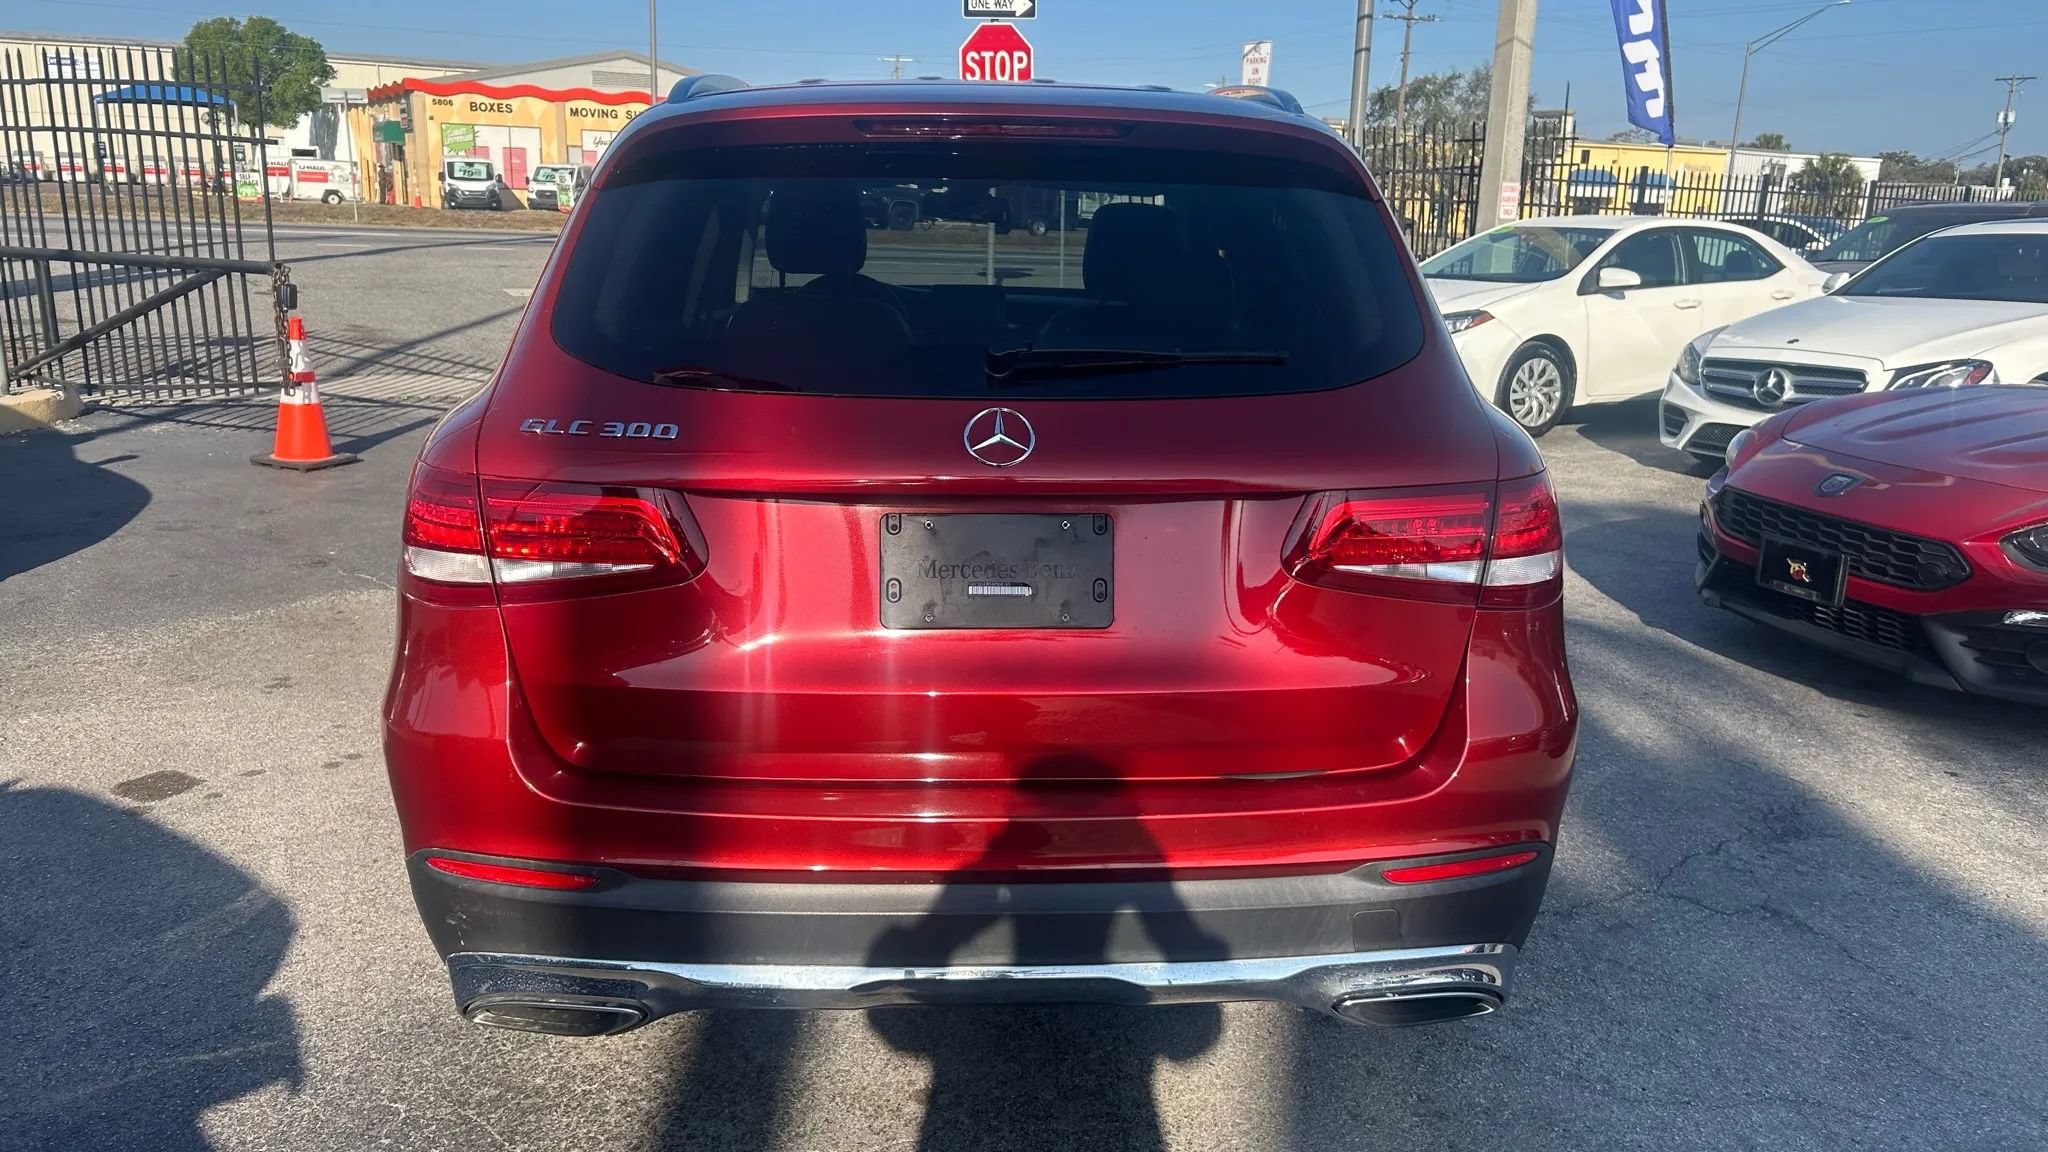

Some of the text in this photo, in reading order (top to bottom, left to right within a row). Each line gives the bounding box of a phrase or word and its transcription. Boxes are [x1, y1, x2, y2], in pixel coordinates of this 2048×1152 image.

[971, 0, 1014, 9] ONE WAY
[965, 50, 1029, 82] STOP
[1245, 57, 1267, 65] PARKING
[1251, 67, 1259, 75] ON
[469, 101, 513, 115] BOXES
[569, 107, 619, 121] MOVING
[519, 417, 680, 440] GLC 300
[917, 559, 1078, 579] Mercedes Benz
